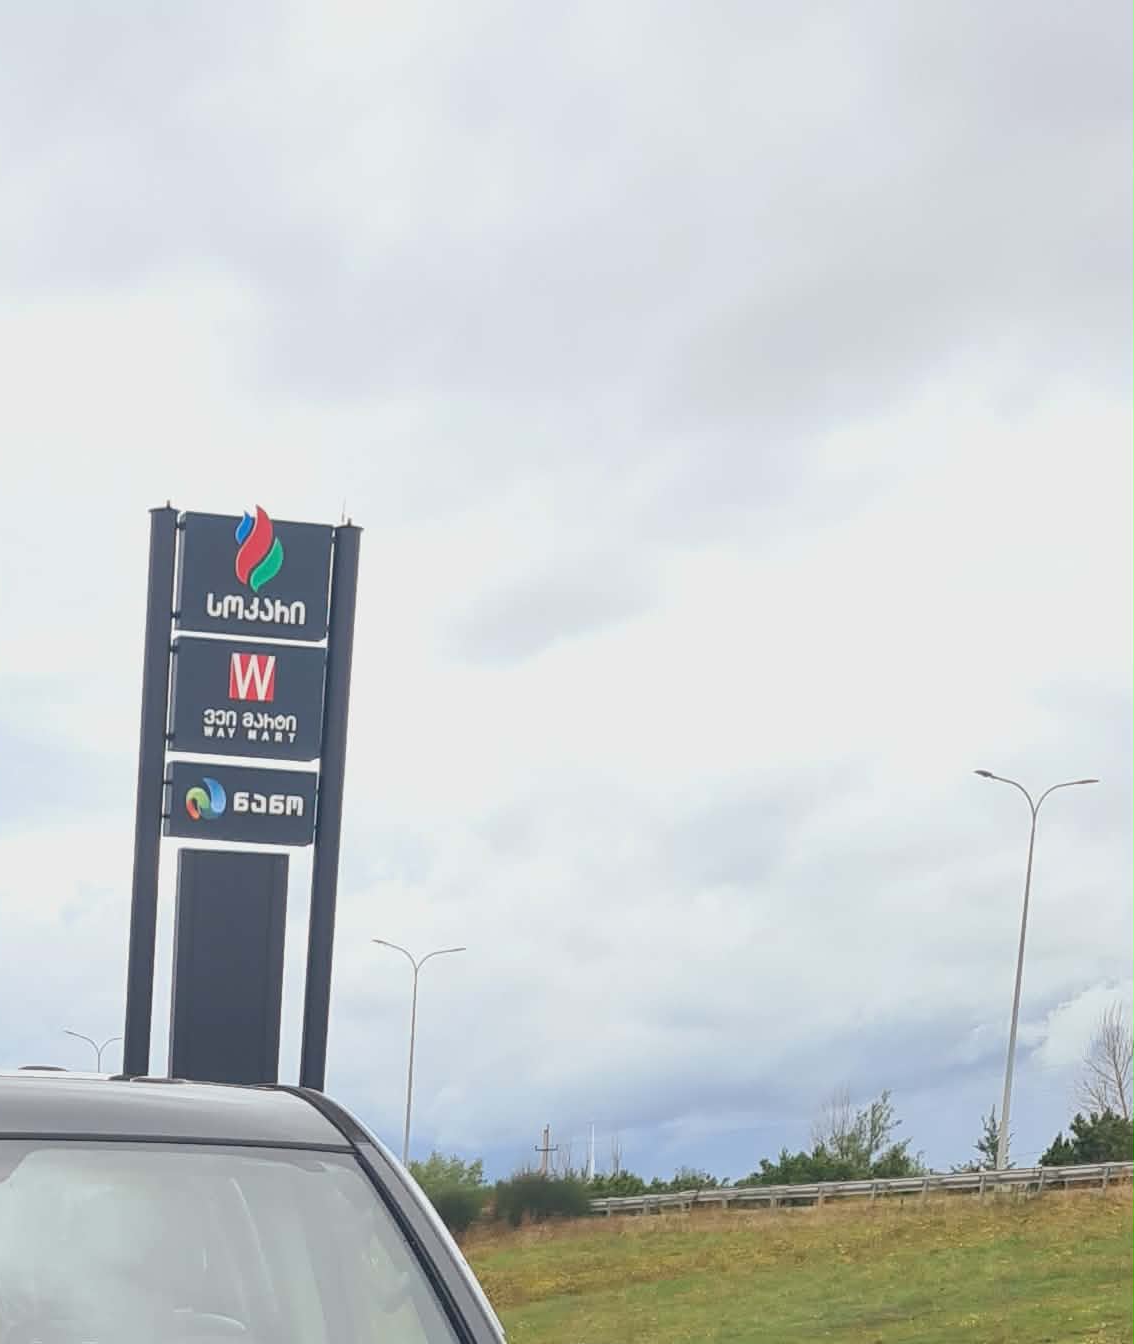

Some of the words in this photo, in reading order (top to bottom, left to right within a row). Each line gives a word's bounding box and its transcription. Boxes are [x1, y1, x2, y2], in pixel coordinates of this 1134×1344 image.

[206, 593, 305, 625] სოკარი
[231, 654, 275, 701] W
[203, 726, 236, 739] WAY
[247, 729, 297, 743] MART
[233, 791, 304, 817] ნანო
